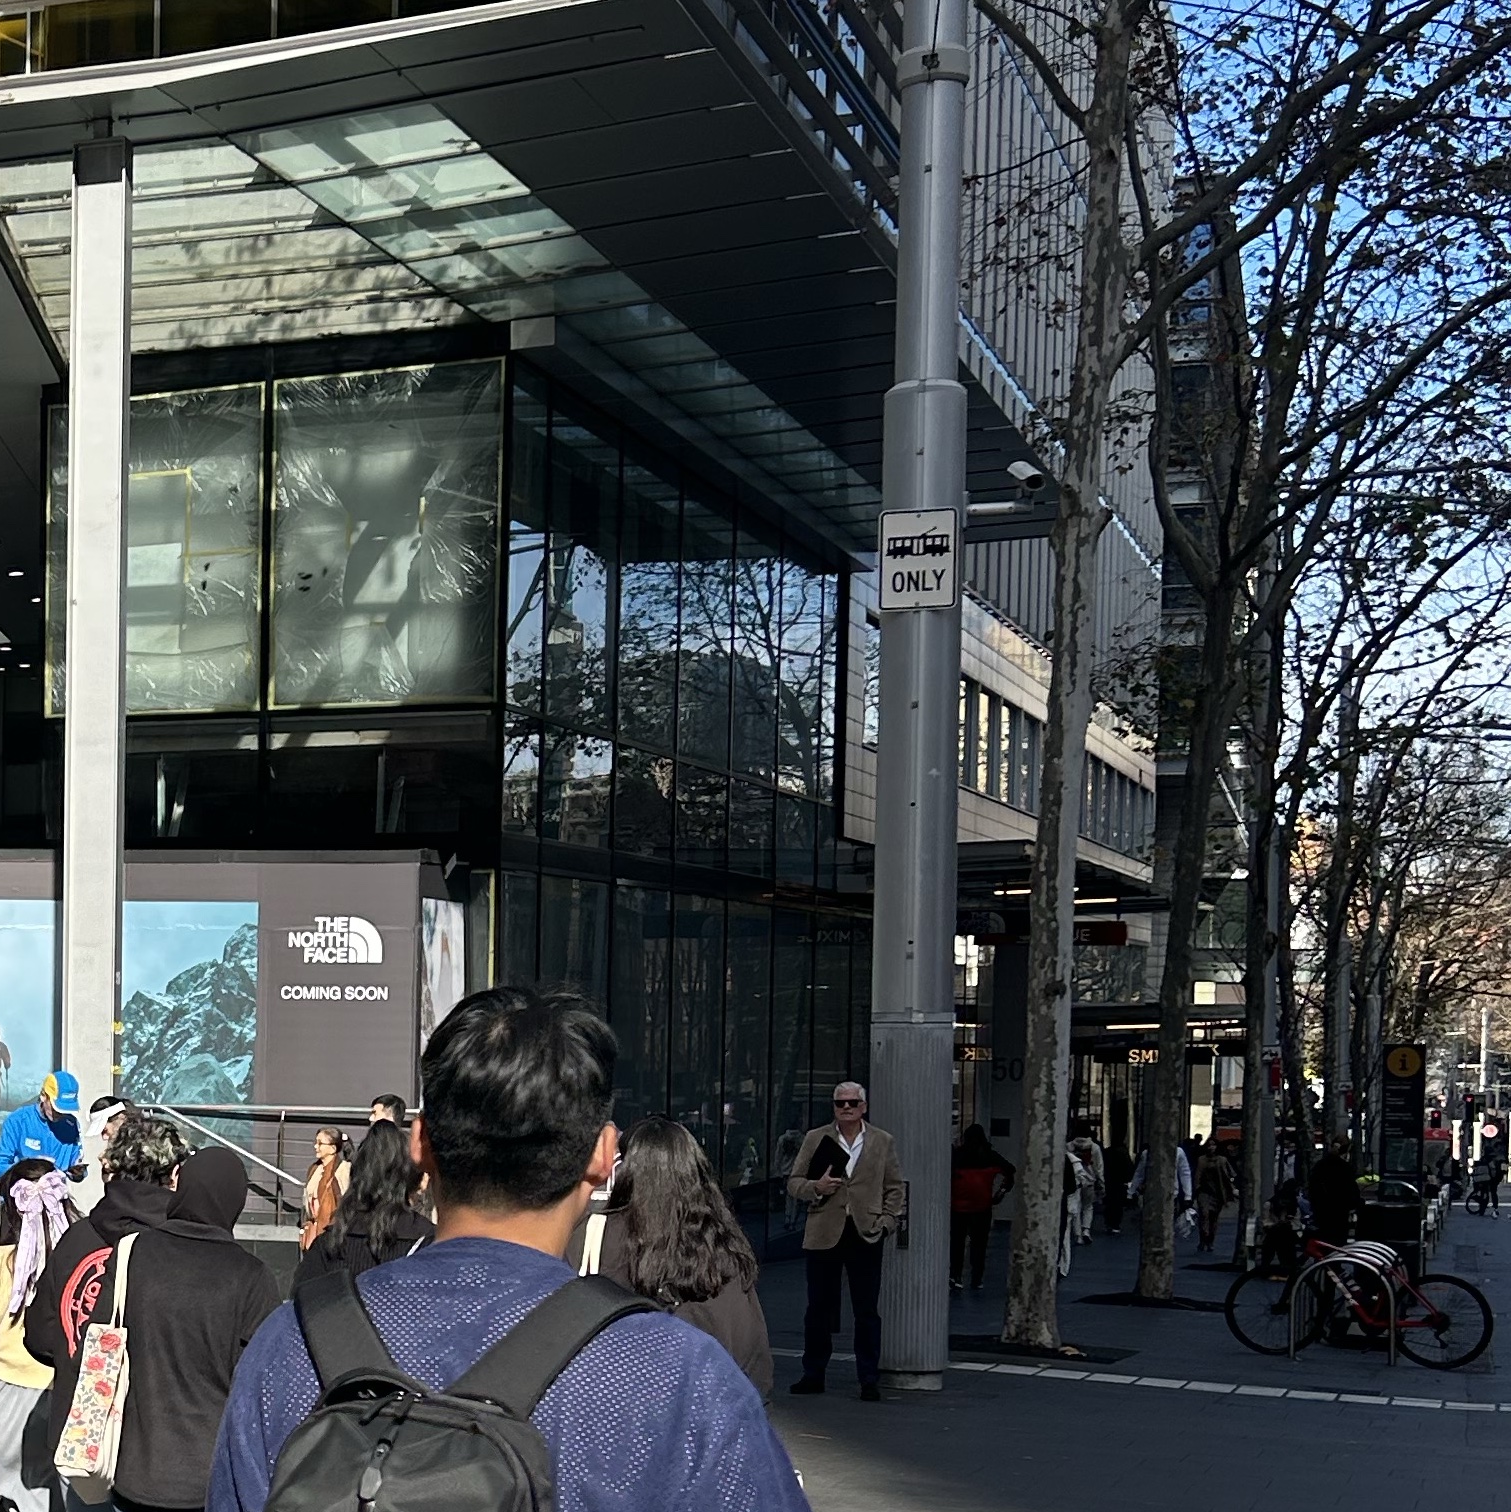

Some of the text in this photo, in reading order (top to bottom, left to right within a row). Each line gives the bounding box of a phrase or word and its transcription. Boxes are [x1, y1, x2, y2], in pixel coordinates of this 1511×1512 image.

[892, 568, 946, 593] ONLY
[314, 916, 349, 932] THE
[288, 932, 349, 948] NORTH
[303, 947, 348, 963] FACE
[280, 985, 389, 1000] COMING SOON
